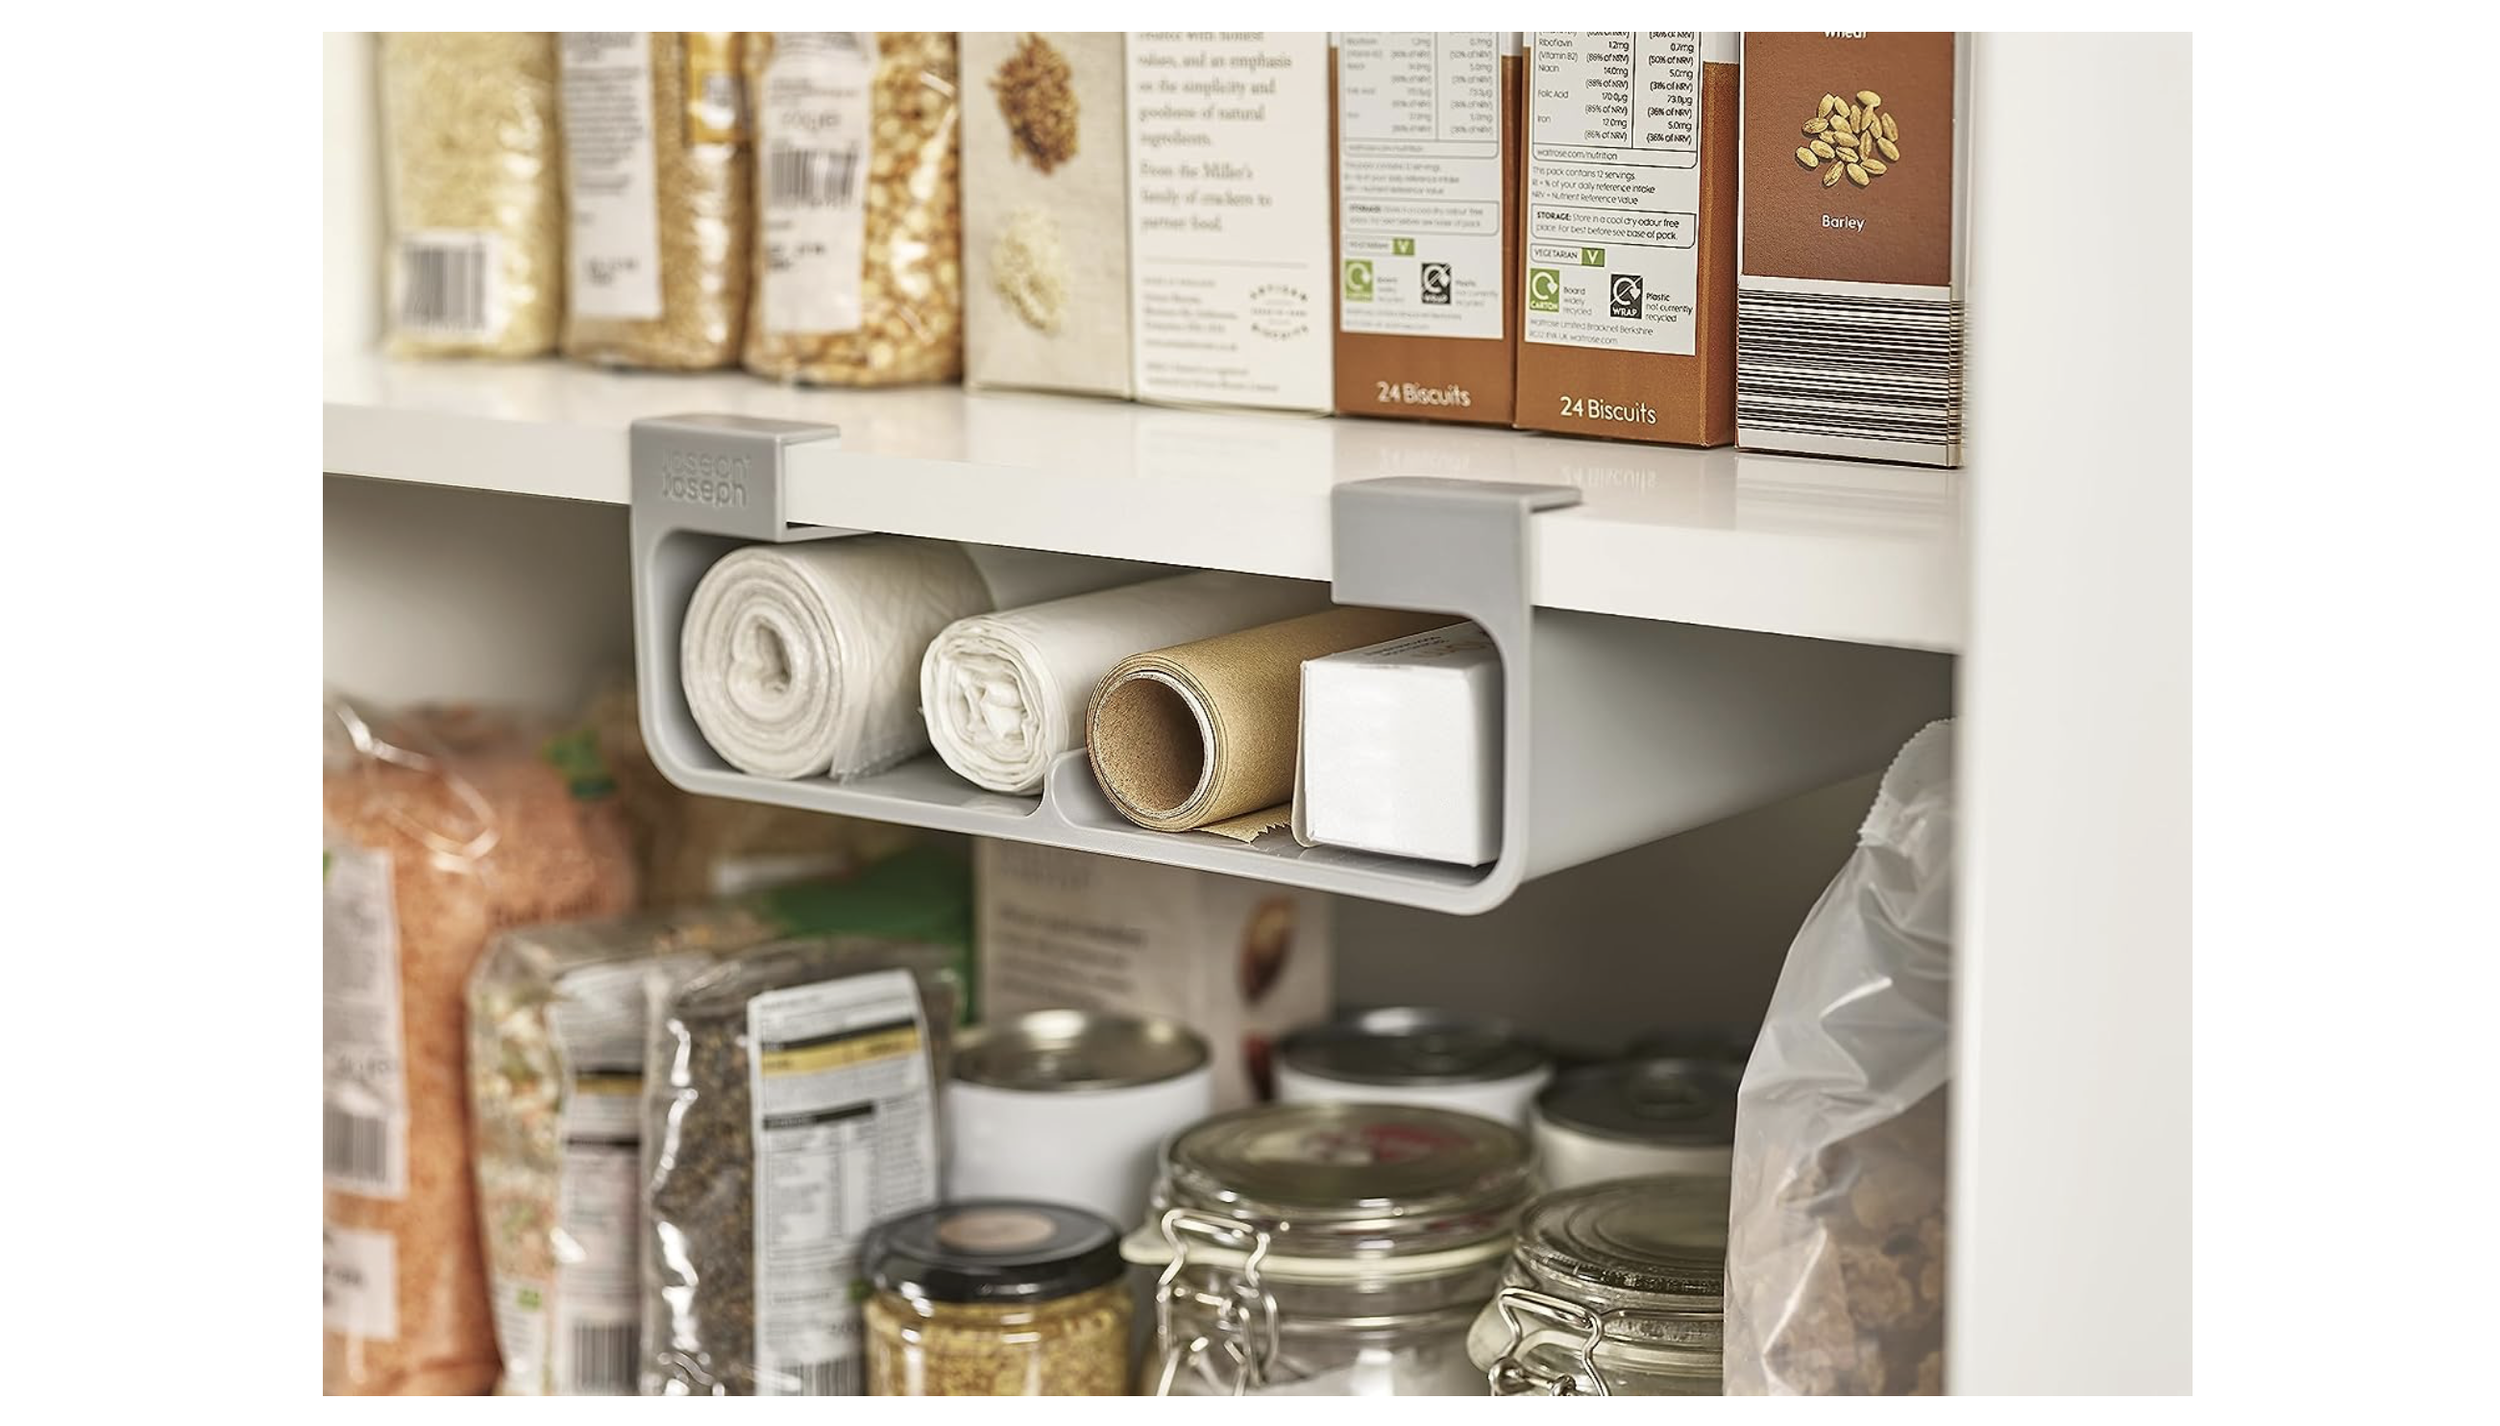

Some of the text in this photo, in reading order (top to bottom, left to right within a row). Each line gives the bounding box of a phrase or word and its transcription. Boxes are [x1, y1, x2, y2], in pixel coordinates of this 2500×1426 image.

[1230, 53, 1292, 71] emphasis
[1603, 53, 1612, 62] of
[1612, 53, 1630, 65] NRV)
[1667, 56, 1675, 64] of
[1676, 56, 1694, 67] NRV)
[1250, 77, 1277, 94] and
[1602, 79, 1611, 88] of
[1611, 79, 1629, 90] NRV)
[1666, 82, 1675, 91] of
[1675, 82, 1694, 94] NRV)
[1554, 90, 1569, 99] Acid
[1219, 104, 1266, 121] natural
[1602, 105, 1611, 114] of
[1611, 105, 1628, 117] NRV)
[1665, 107, 1674, 116] of
[1674, 108, 1692, 120] NRV)
[1601, 130, 1610, 140] of
[1610, 131, 1628, 142] NRV)
[1664, 134, 1673, 143] of
[1674, 134, 1692, 145] NRV)
[1546, 168, 1565, 177] pack
[1565, 168, 1596, 178] contains
[1551, 180, 1560, 188] of
[1560, 181, 1577, 190] your
[1578, 182, 1595, 192] daily
[1596, 182, 1632, 193] reference
[1632, 184, 1656, 194] intake
[1580, 193, 1617, 203] Reference
[1572, 212, 1592, 222] Store
[1624, 216, 1637, 227] dry
[1637, 218, 1662, 227] odour
[1663, 218, 1680, 228] free
[1821, 213, 1867, 232] Barley
[1570, 225, 1587, 234] best
[1587, 226, 1612, 237] before
[1612, 228, 1626, 238] see
[1626, 229, 1646, 239] base
[1646, 230, 1655, 239] of
[1534, 247, 1600, 265] VEGETARIAN V
[1563, 286, 1586, 295] Board
[1646, 292, 1671, 302] Plastic
[1612, 305, 1639, 317] WRAP
[1645, 303, 1694, 316] not currently
[1645, 313, 1678, 323] recycled
[1376, 381, 1472, 407] 24 Biscuits
[1559, 395, 1658, 425] 24 Biscuits
